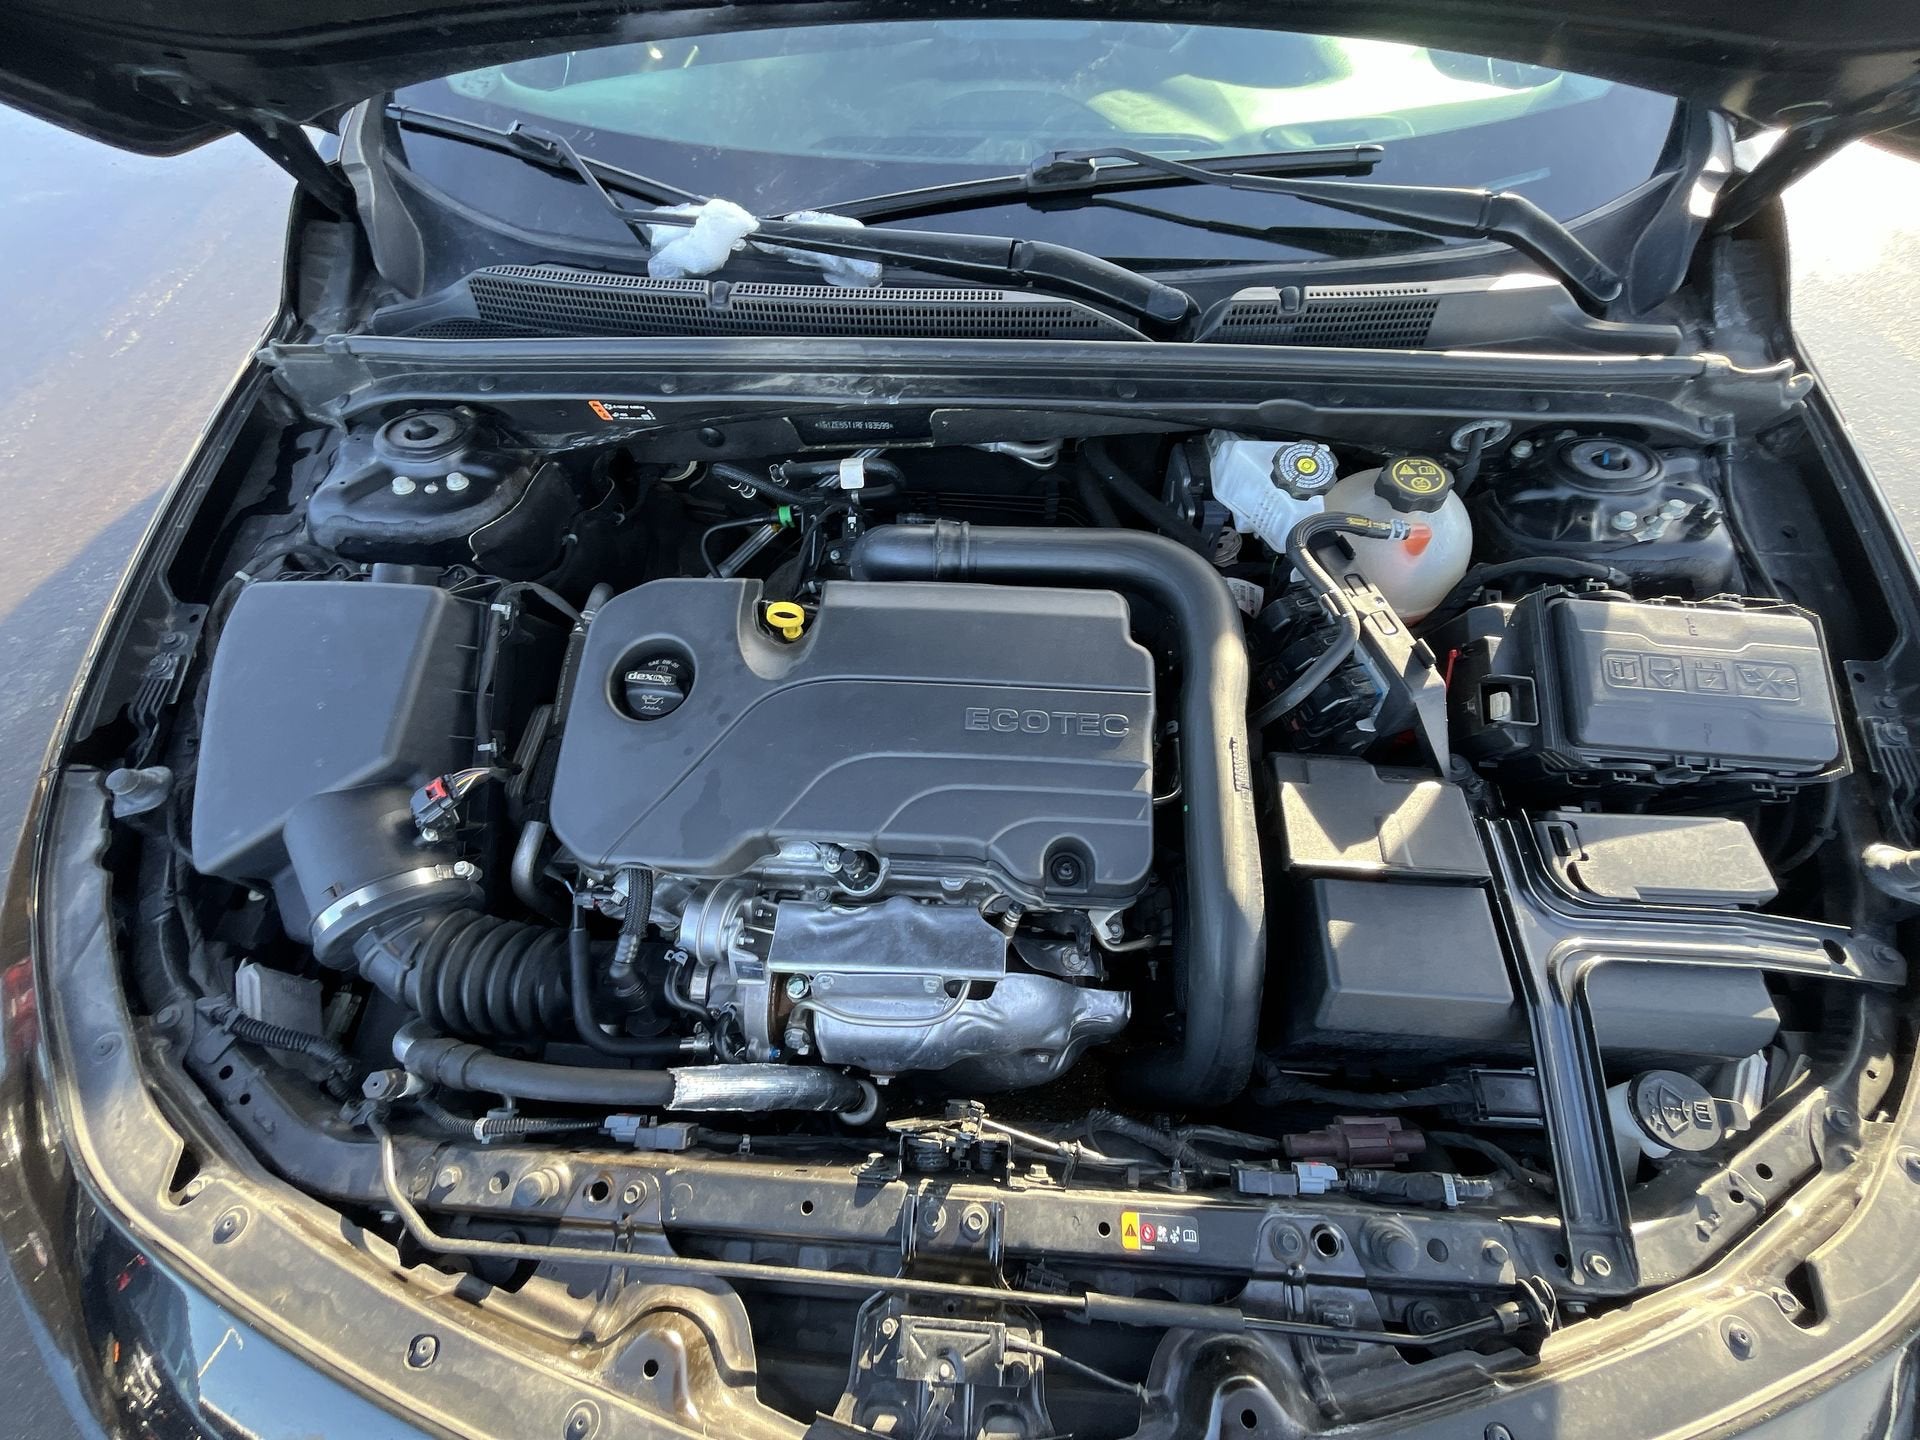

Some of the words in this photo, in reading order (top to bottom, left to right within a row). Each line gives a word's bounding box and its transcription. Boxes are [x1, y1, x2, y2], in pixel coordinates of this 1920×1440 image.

[648, 659, 660, 667] SAE
[628, 671, 672, 685] dexos
[965, 707, 1130, 738] ECOTEC
